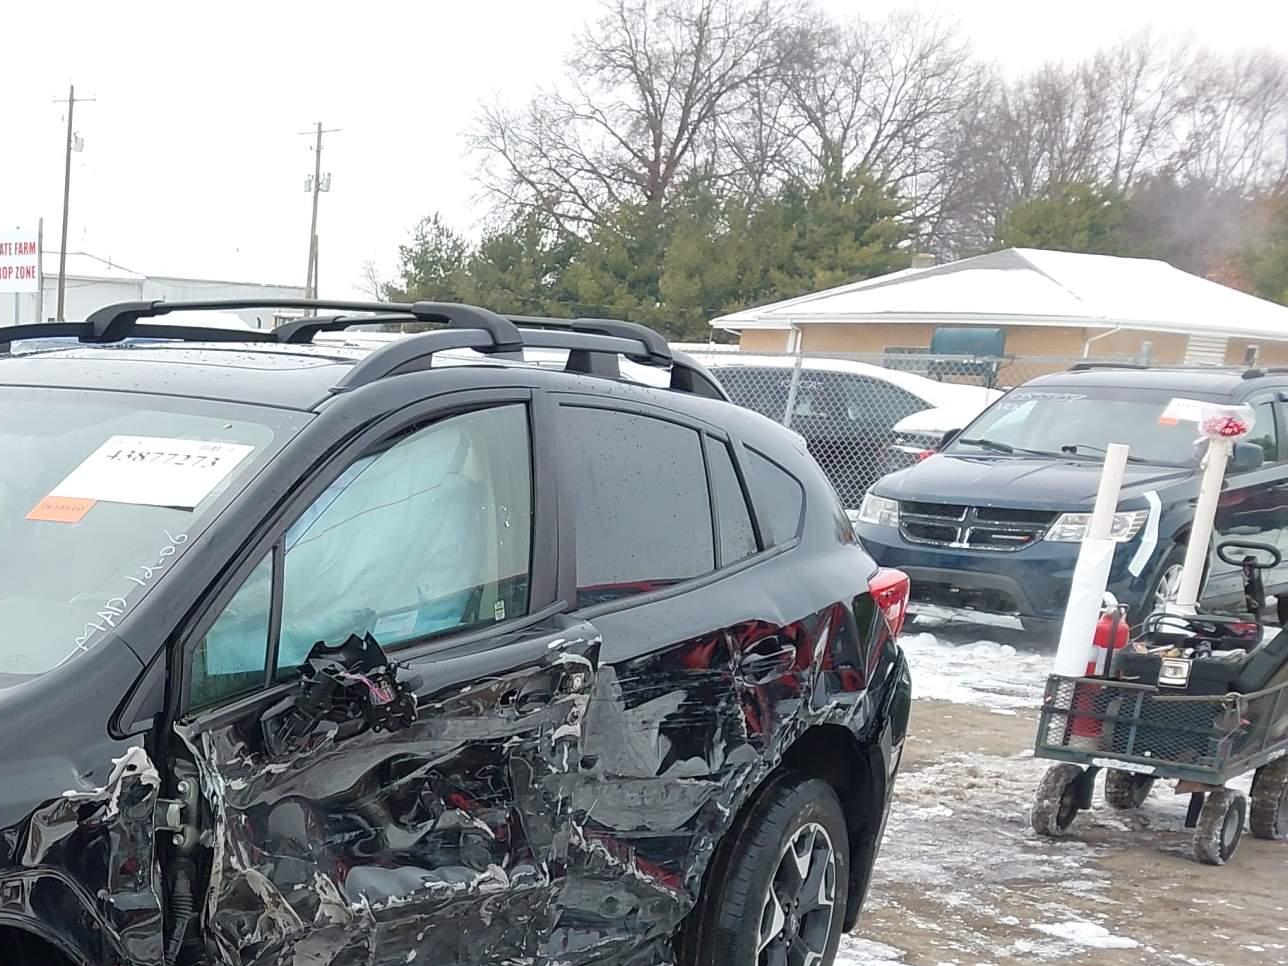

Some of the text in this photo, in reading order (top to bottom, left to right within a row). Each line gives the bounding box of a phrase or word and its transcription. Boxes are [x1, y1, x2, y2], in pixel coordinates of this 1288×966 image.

[14, 241, 36, 255] FARM
[15, 265, 36, 279] ZONE
[124, 528, 189, 587] 12-06
